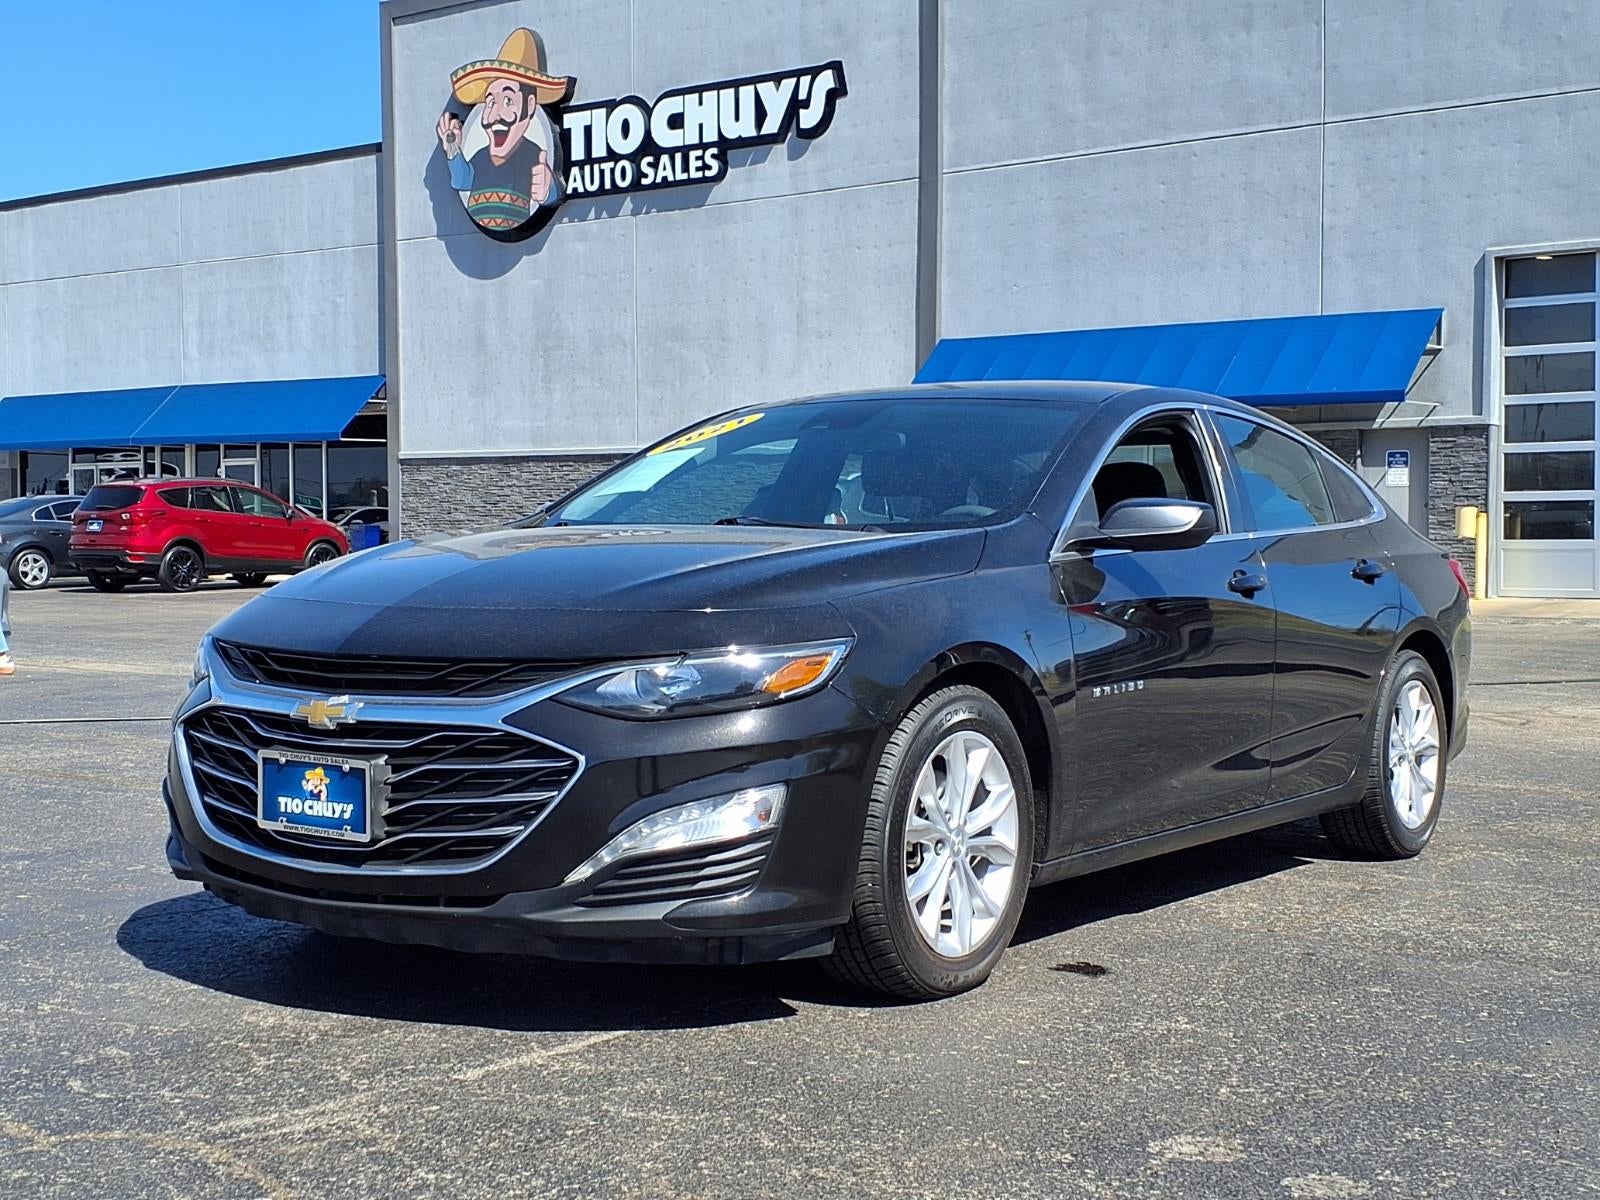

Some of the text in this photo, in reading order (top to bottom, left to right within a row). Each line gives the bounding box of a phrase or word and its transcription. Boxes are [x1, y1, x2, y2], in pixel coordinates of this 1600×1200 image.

[563, 69, 836, 160] TIO CHUY'S
[567, 147, 719, 194] AUTO SALES
[313, 755, 329, 763] AUTO
[277, 796, 354, 820] TIO CHUY'S
